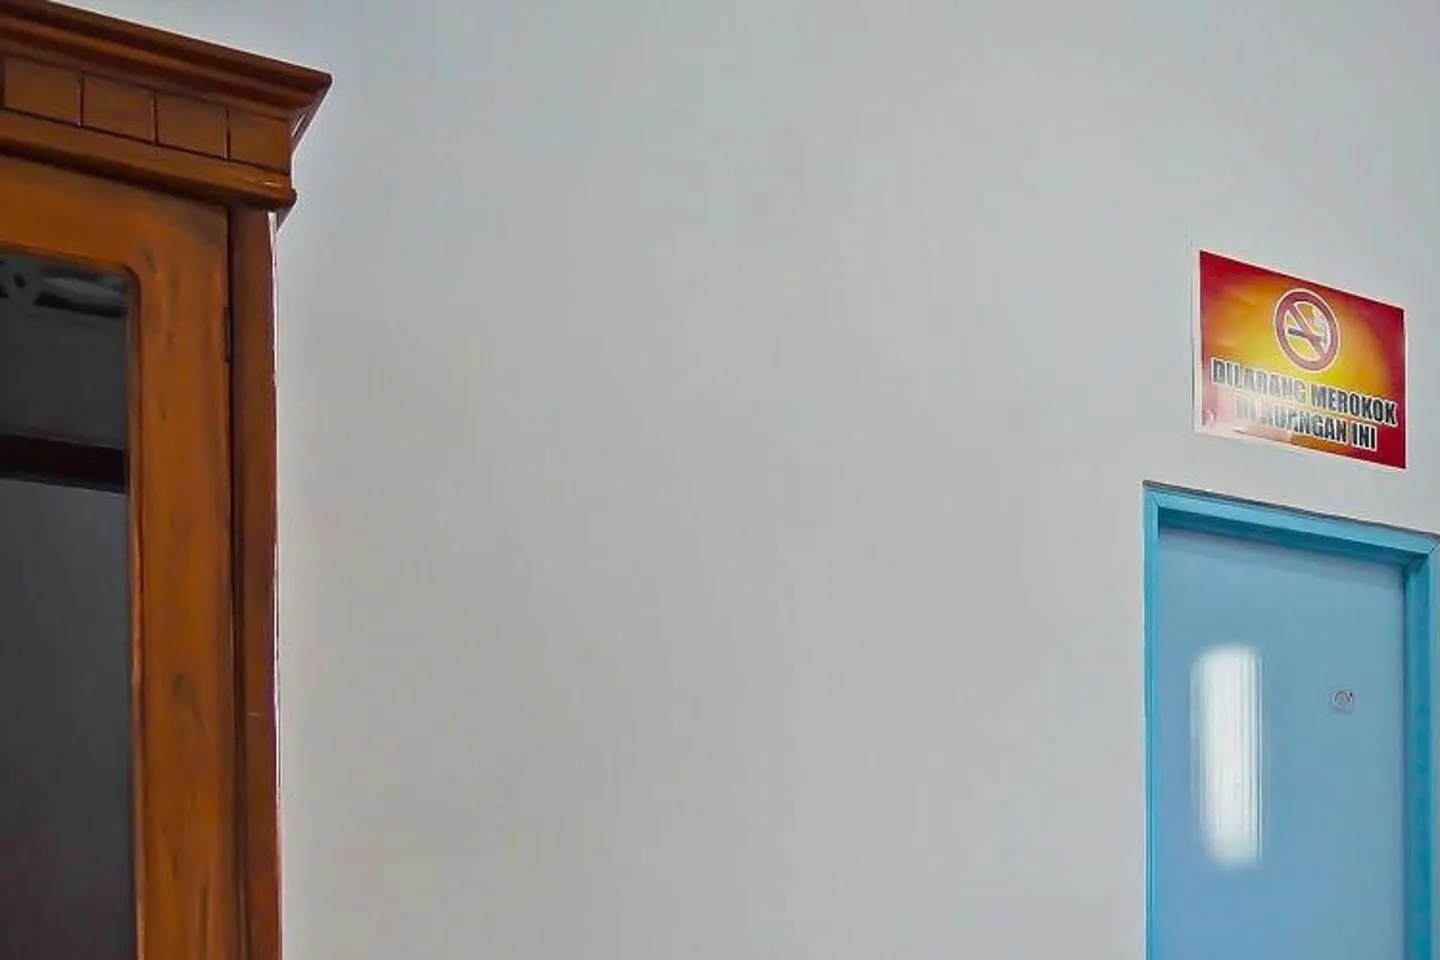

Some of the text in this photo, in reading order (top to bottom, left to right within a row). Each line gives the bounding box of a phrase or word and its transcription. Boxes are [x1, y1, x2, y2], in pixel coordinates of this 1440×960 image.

[1212, 358, 1398, 427] DILARANG MEROKOK
[1350, 424, 1377, 451] INI
